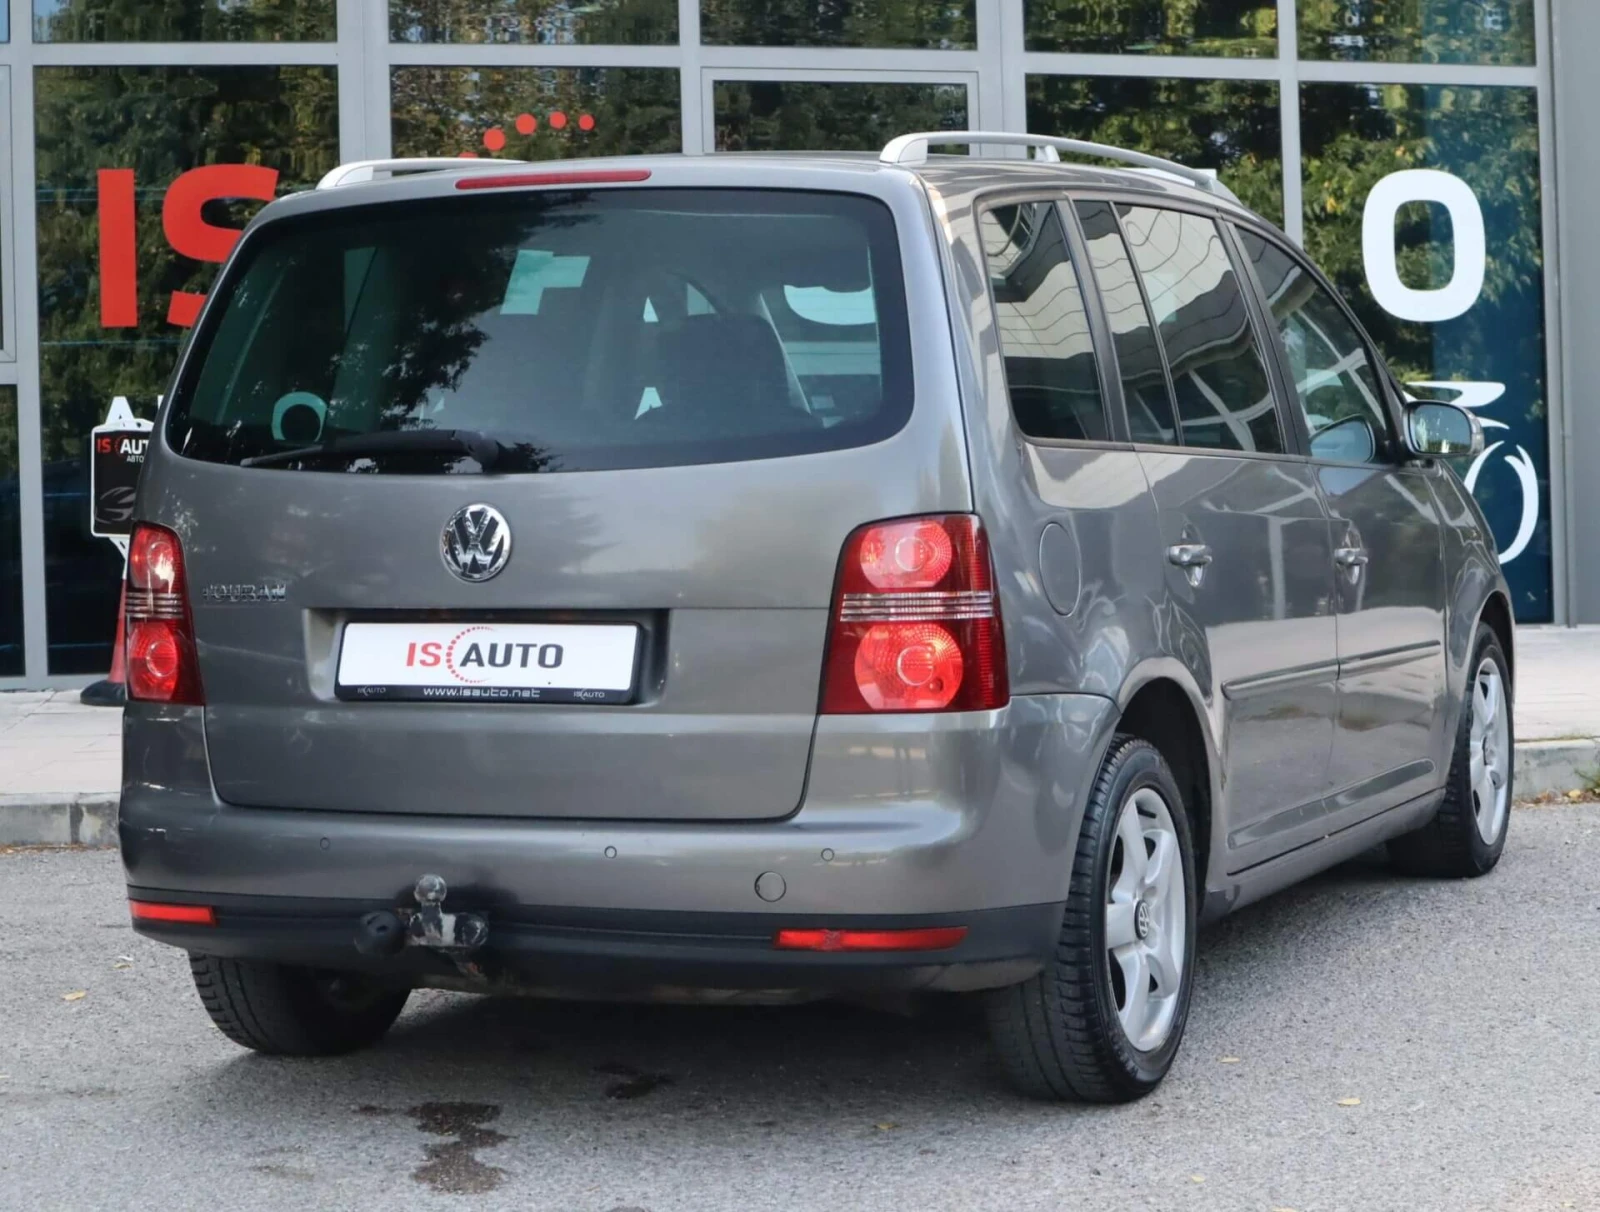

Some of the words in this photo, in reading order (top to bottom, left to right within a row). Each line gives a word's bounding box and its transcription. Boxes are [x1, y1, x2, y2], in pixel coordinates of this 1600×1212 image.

[97, 164, 279, 327] IS
[97, 438, 111, 453] IS
[406, 642, 442, 667] IS
[460, 642, 564, 669] AUTO
[423, 686, 541, 698] www.isauto.net
